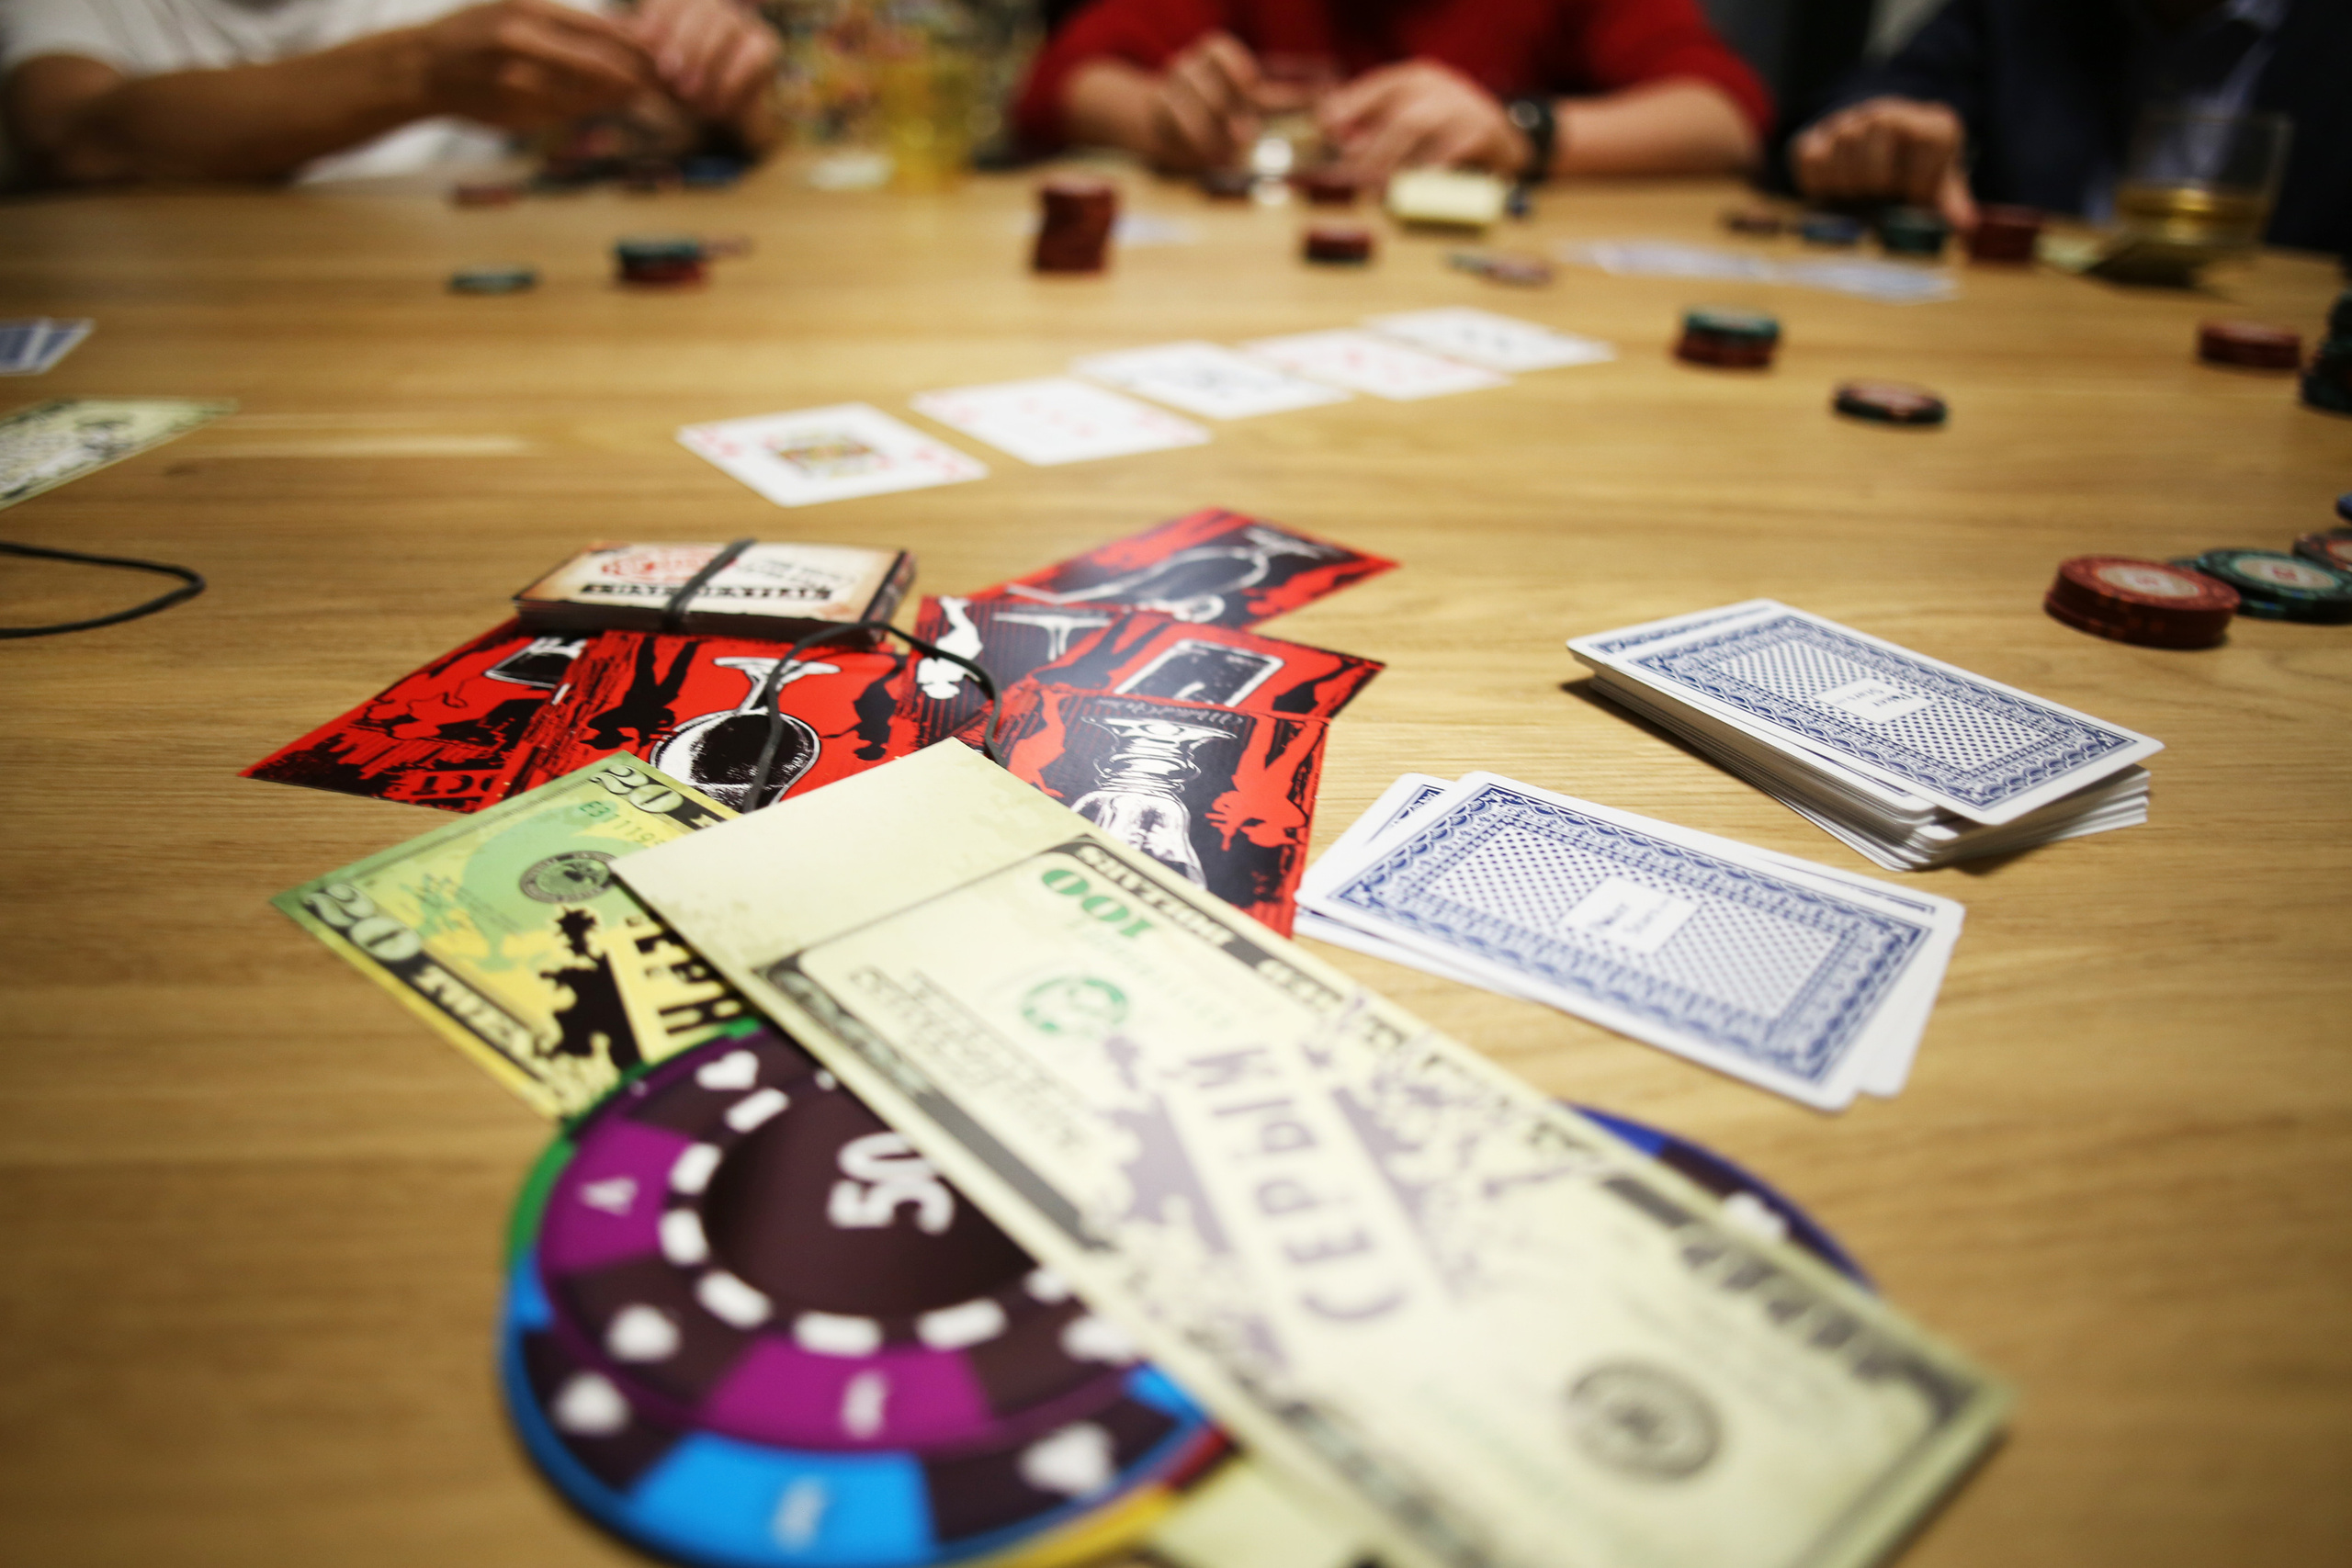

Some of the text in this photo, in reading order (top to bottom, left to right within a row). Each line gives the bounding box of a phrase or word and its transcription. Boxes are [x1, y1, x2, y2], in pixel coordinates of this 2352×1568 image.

[590, 764, 684, 814] 20
[304, 883, 423, 962] 20
[1041, 868, 1157, 940] 100
